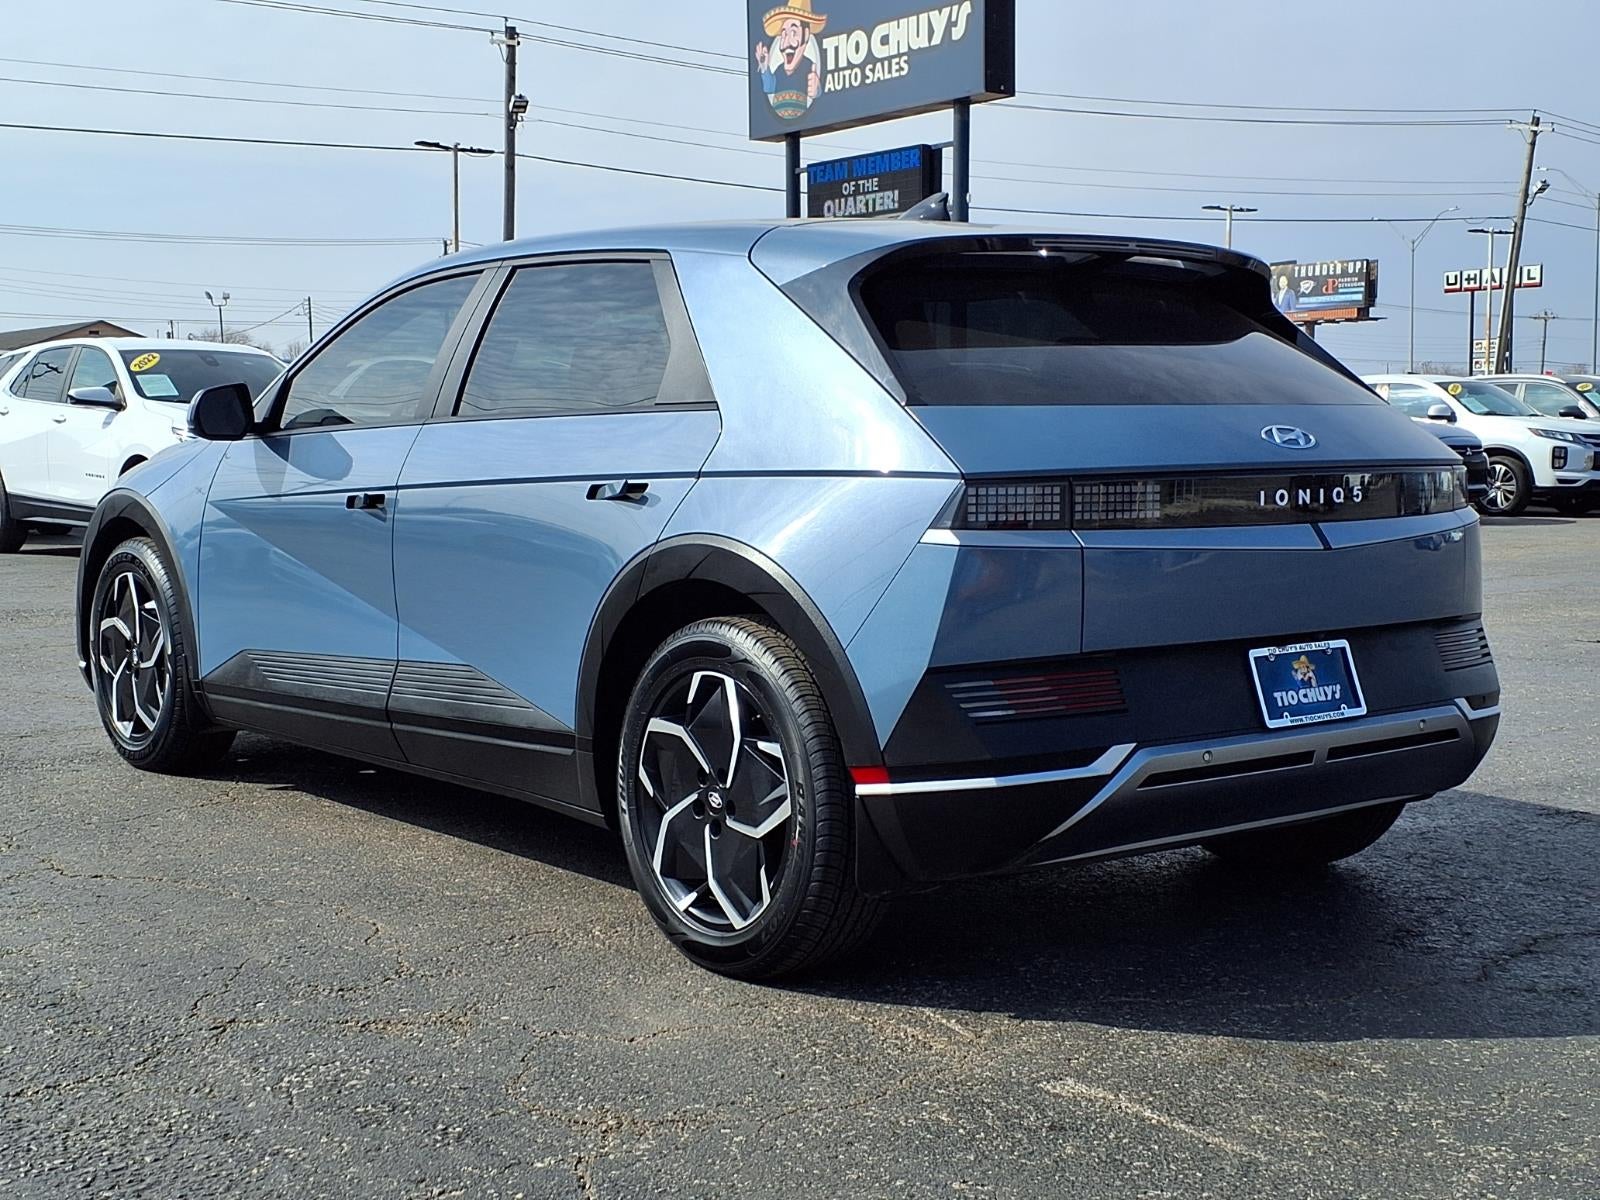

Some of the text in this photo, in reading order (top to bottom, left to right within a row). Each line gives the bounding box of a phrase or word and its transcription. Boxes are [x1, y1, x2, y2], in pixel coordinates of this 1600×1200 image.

[823, 1, 972, 71] TIO CHUY'S
[825, 56, 909, 93] AUTO SALES
[808, 149, 920, 184] TEAM MEMBER
[842, 178, 879, 195] OF THE
[823, 190, 899, 217] QUARTER!
[1294, 260, 1367, 278] THUNDER UP!
[133, 353, 157, 370] 2022
[1260, 486, 1362, 506] IONIQ 5
[1314, 641, 1330, 649] SALES
[1273, 683, 1341, 707] TIO CHUY'S
